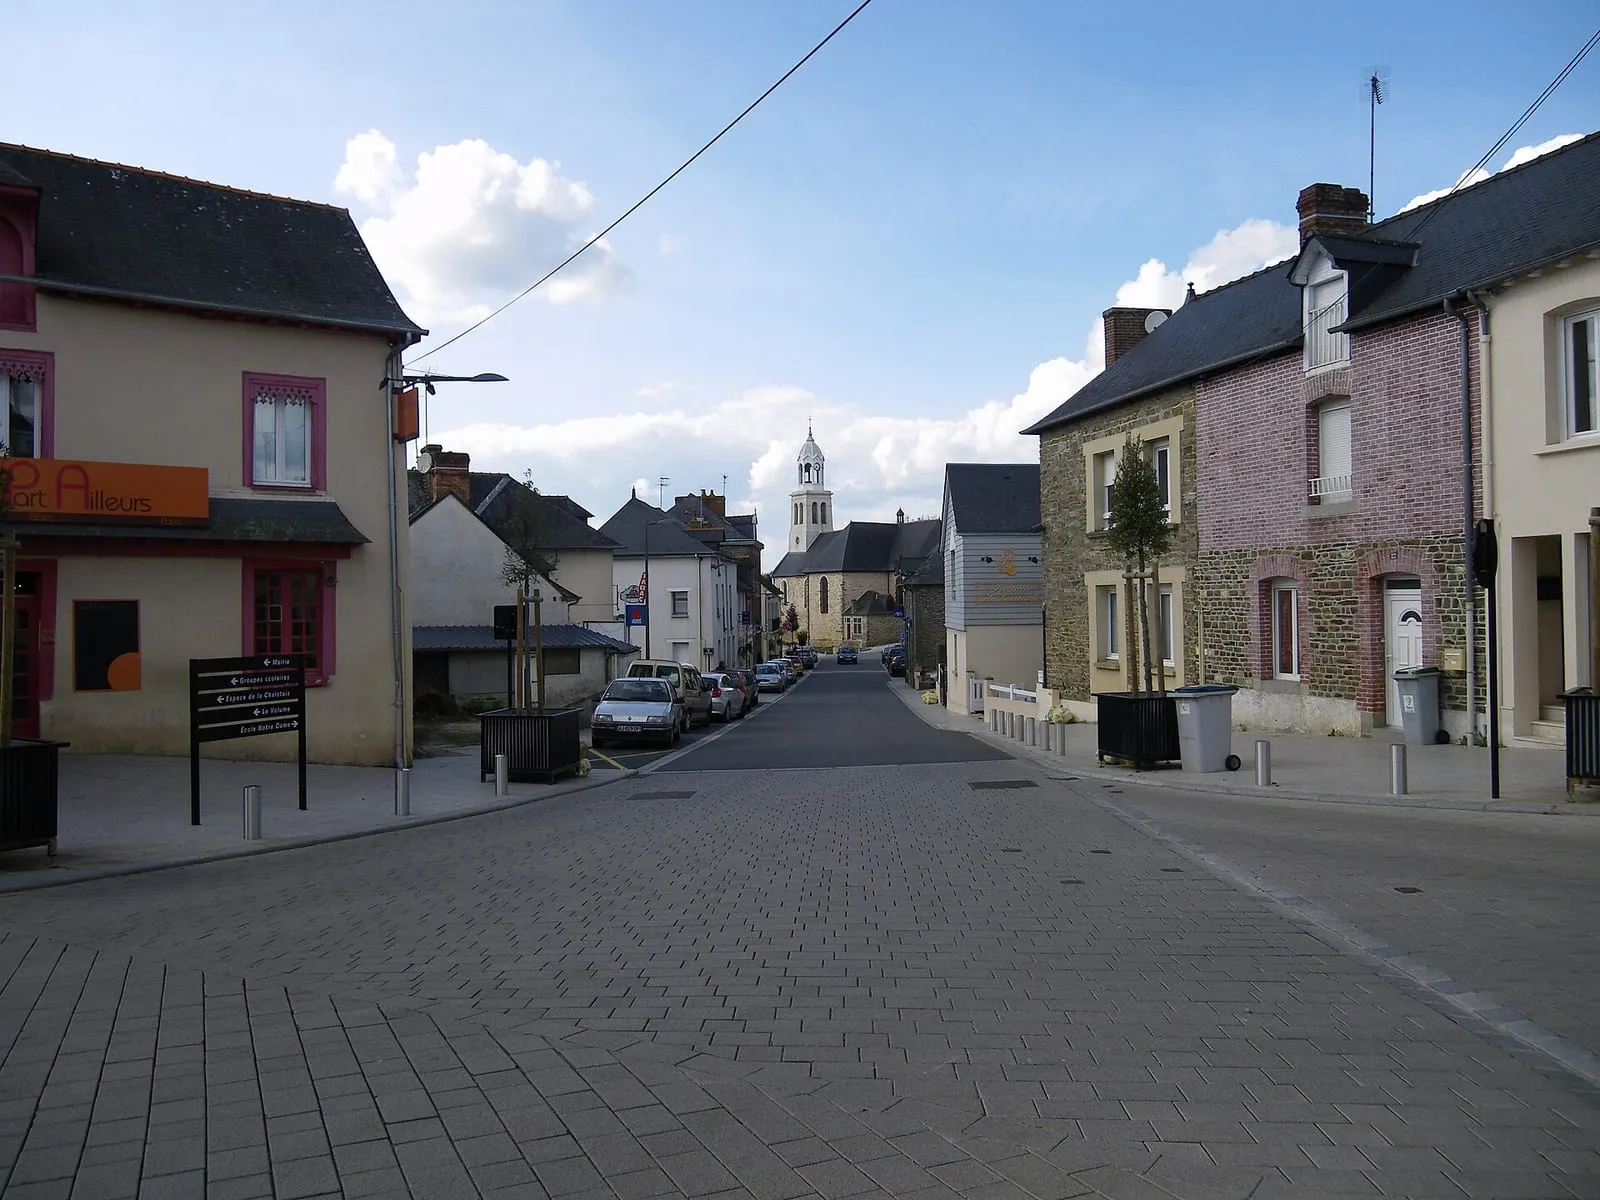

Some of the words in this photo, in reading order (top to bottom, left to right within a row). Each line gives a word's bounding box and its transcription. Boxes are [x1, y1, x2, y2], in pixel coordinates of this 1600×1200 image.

[7, 460, 47, 508] Part
[56, 464, 152, 512] Ailleurs
[226, 694, 246, 703] Espace
[270, 706, 290, 714] Volume
[258, 722, 274, 731] Notre
[275, 721, 291, 729] Dame
